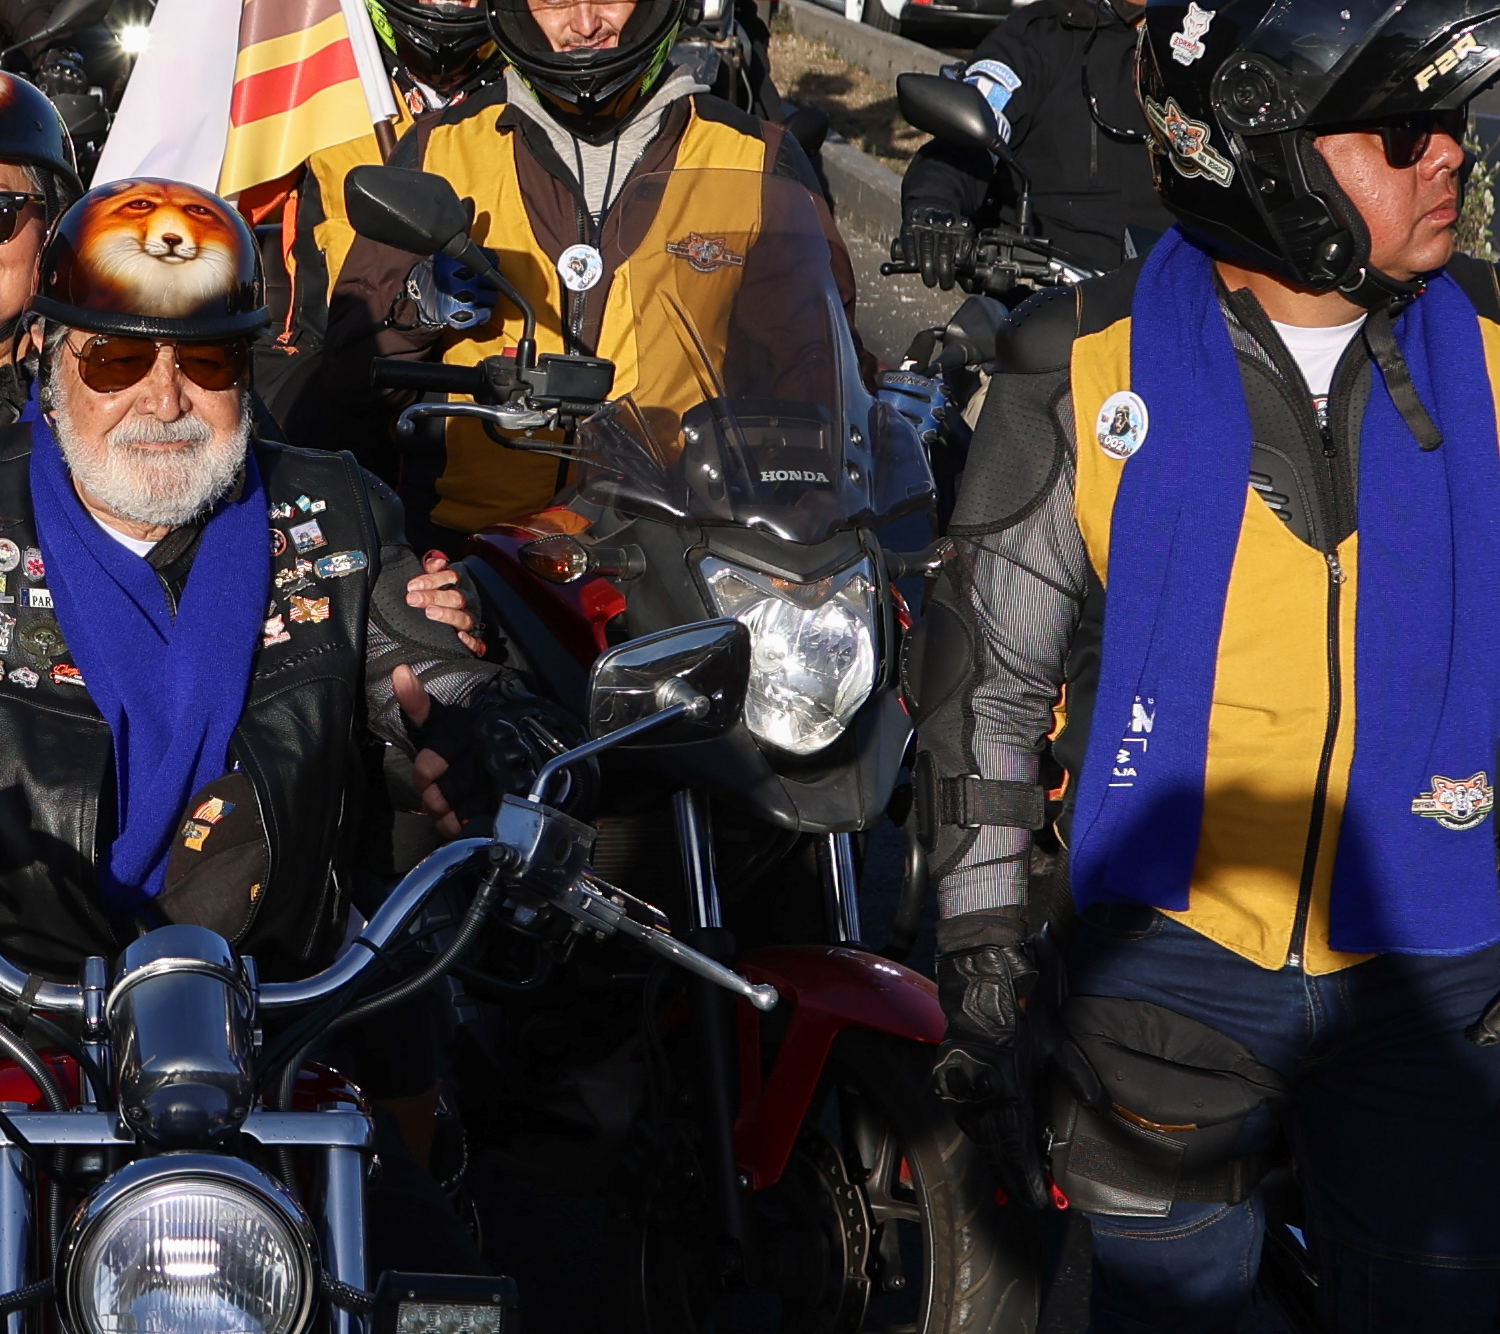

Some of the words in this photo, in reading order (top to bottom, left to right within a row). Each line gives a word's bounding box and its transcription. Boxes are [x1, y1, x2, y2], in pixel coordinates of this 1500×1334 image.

[1414, 32, 1486, 92] F2R
[1104, 434, 1126, 451] 002
[760, 470, 829, 483] HONDA
